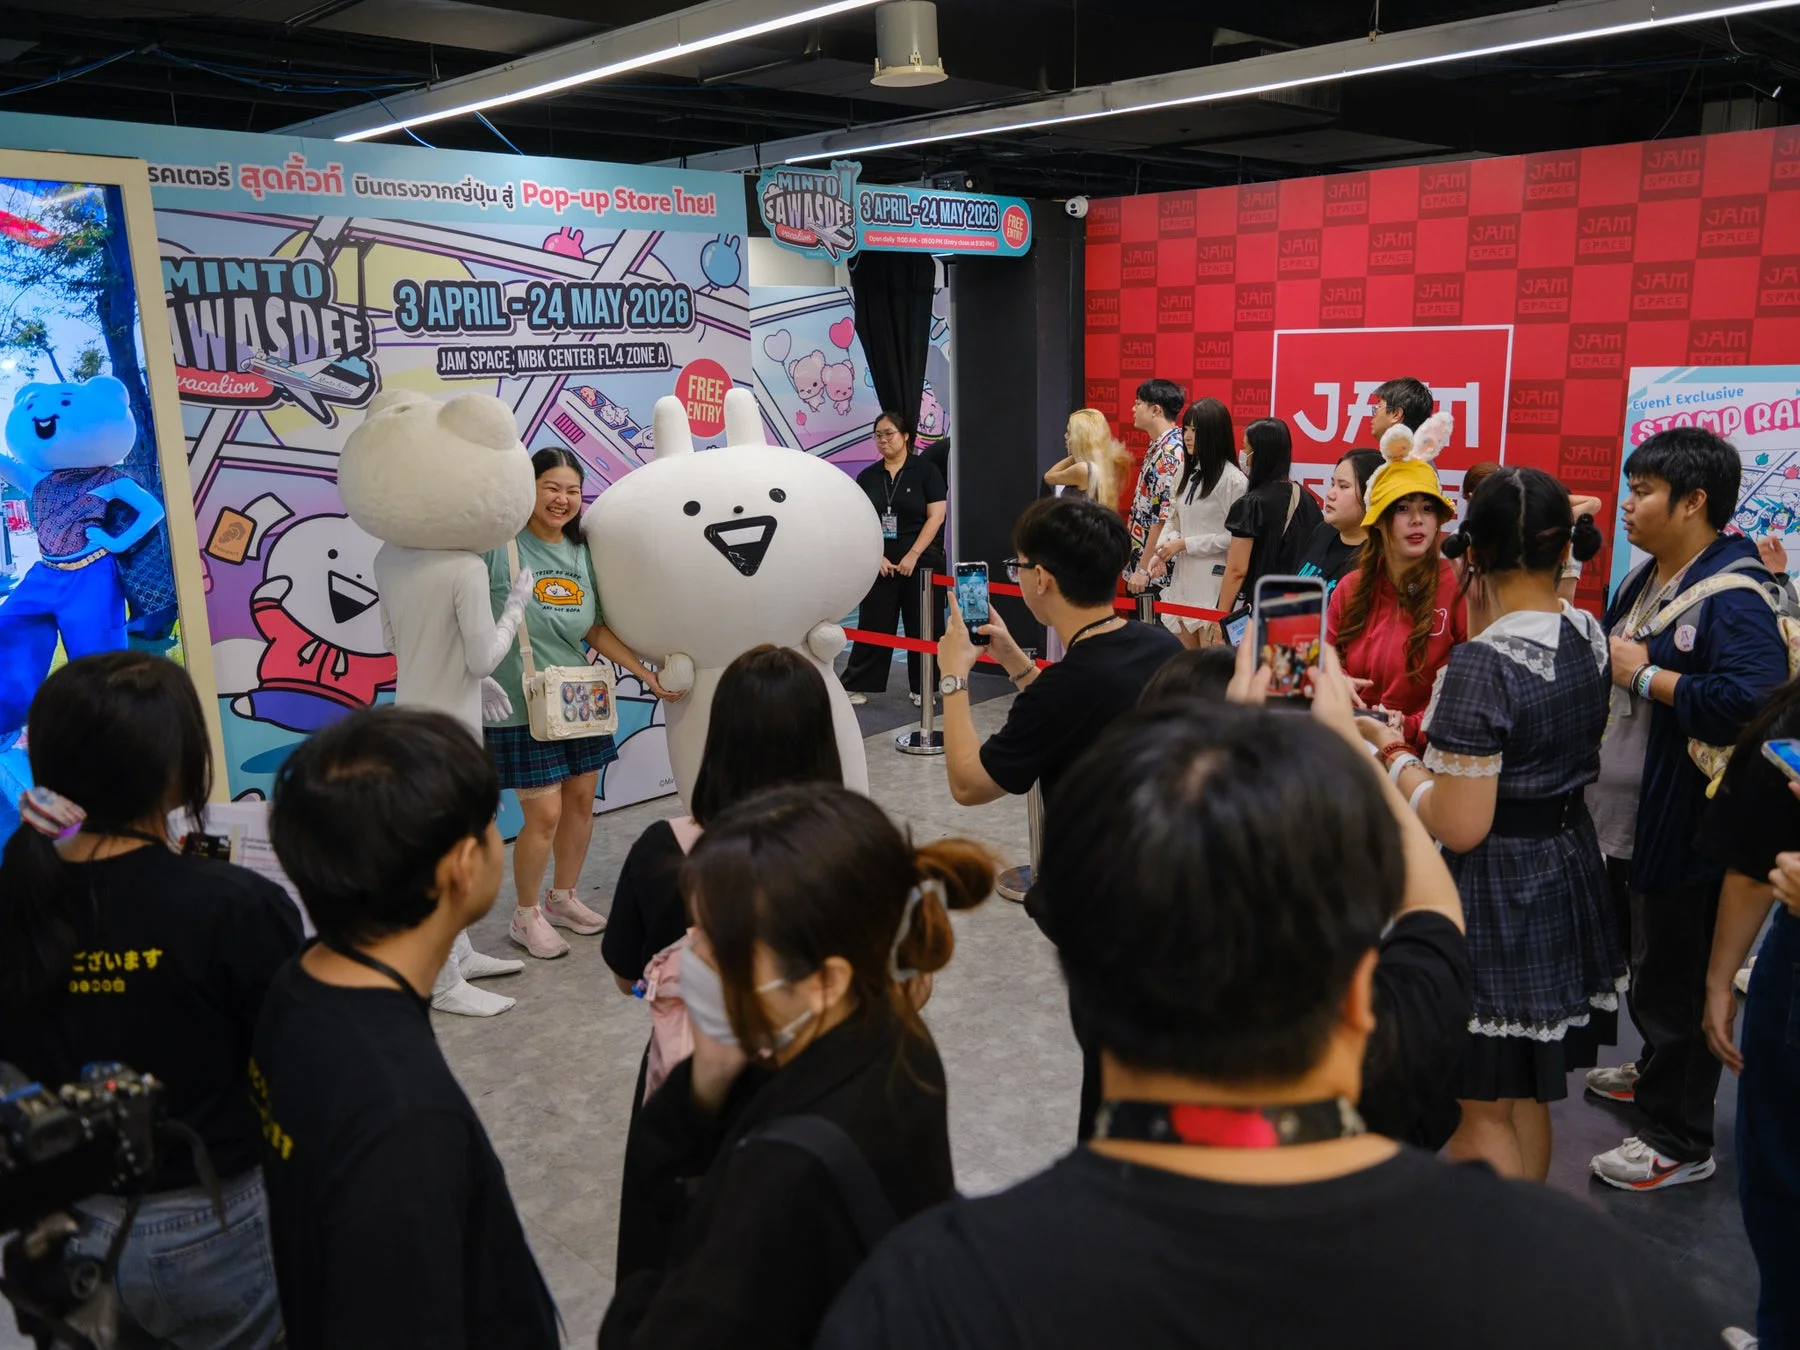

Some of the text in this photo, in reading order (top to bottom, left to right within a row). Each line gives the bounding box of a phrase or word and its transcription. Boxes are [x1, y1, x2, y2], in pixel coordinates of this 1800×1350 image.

[1647, 149, 1699, 168] JAM
[1530, 161, 1576, 180] JAM
[778, 173, 837, 196] MINTO
[1424, 172, 1466, 190] JAM
[1328, 181, 1366, 198] JAM
[1531, 185, 1571, 197] SPACE
[523, 183, 609, 215] Pop-up
[614, 189, 670, 212] Store
[1241, 192, 1277, 208] JAM
[1425, 195, 1462, 207] SPACE
[765, 193, 851, 231] SAWASDEE
[863, 195, 871, 218] 3
[874, 197, 912, 222] APRIL
[921, 200, 938, 222] 24
[940, 201, 966, 225] MAY
[967, 202, 997, 227] 2026
[1089, 206, 1119, 221] JAM
[1161, 200, 1194, 215] JAM
[1007, 214, 1024, 231] FREE
[1705, 206, 1760, 226] JAM
[1472, 224, 1516, 241] JAM
[1582, 216, 1631, 234] JAM
[1007, 228, 1024, 242] ENTRY
[1373, 232, 1412, 247] JAM
[1706, 231, 1755, 244] SPACE
[1200, 244, 1234, 259] JAM
[1282, 238, 1318, 254] JAM
[1473, 246, 1511, 258] SPACE
[1584, 239, 1626, 251] SPACE
[1124, 250, 1155, 265] JAM
[1373, 253, 1409, 264] SPACE
[162, 260, 323, 298] MINTO
[1521, 277, 1568, 294] JAM
[1637, 272, 1688, 290] JAM
[1238, 291, 1273, 305] JAM
[1324, 287, 1362, 302] JAM
[1418, 283, 1460, 298] JAM
[400, 286, 417, 326] 3
[427, 286, 506, 326] APRIL
[530, 286, 565, 325] 24
[571, 287, 624, 325] MAY
[629, 287, 689, 324] 2026
[1087, 298, 1118, 311] JAM
[1160, 294, 1192, 309] JAM
[1523, 300, 1563, 311] SPACE
[1638, 297, 1683, 308] SPACE
[1240, 311, 1271, 321] SPACE
[1326, 307, 1359, 317] SPACE
[1420, 304, 1456, 315] SPACE
[1573, 333, 1622, 349] JAM
[1693, 330, 1747, 348] JAM
[1123, 342, 1154, 355] JAM
[1197, 340, 1231, 355] JAM
[441, 351, 467, 371] JAM
[517, 349, 546, 368] MBK
[549, 349, 596, 368] CENTER
[599, 348, 624, 366] FL.4
[626, 347, 656, 365] ZONE
[657, 347, 666, 364] A
[1574, 356, 1616, 367] SPACE
[688, 375, 724, 404] FREE
[1087, 386, 1117, 399] JAM
[1235, 387, 1269, 401] JAM
[1513, 390, 1559, 405] JAM
[1632, 386, 1744, 410] Event Exclusive
[687, 402, 722, 424] ENTRY
[1564, 446, 1611, 462] JAM
